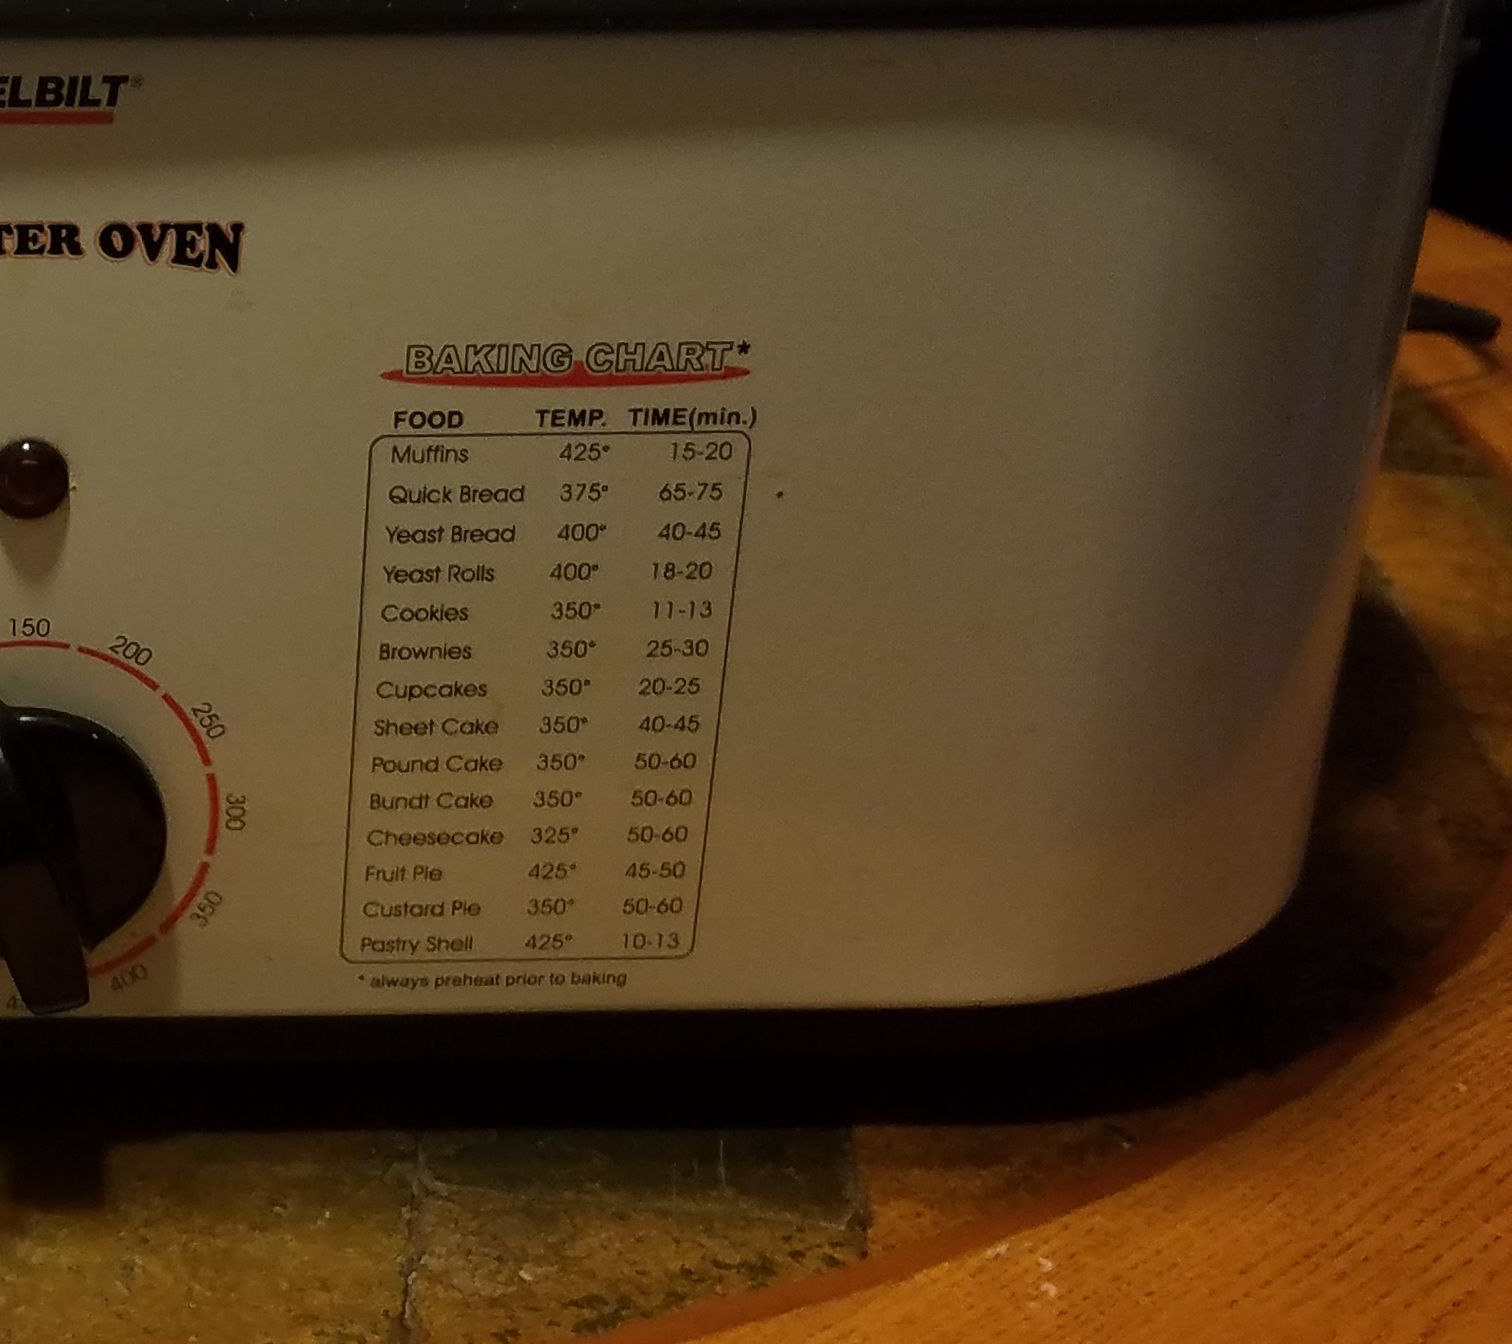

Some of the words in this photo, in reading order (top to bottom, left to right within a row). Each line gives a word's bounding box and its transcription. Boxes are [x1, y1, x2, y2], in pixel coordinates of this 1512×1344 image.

[97, 222, 246, 276] OVEN
[405, 343, 572, 375] BAKING
[394, 410, 464, 429] FOOD
[535, 408, 606, 428] TEMP.
[629, 407, 757, 433] TIME(min.)
[391, 444, 469, 464] Muffins
[671, 442, 733, 461] 15-20
[388, 486, 452, 506] Quick
[460, 485, 525, 503] Bread
[659, 484, 723, 502] 65-75
[385, 526, 446, 545] Yeast
[451, 525, 515, 544] Bread
[657, 523, 721, 541] 40-45
[383, 566, 442, 584] Yeast
[448, 565, 494, 583] Rolls
[651, 562, 712, 580] 18-20
[381, 604, 469, 623] Cookies
[653, 601, 713, 620] 11-13
[9, 617, 51, 638] 150
[110, 634, 153, 667] 200
[379, 642, 472, 661] Brownies
[646, 639, 709, 658] 25-30
[376, 681, 487, 702] Cupcakes
[638, 678, 700, 696] 20-25
[191, 701, 227, 741] 250
[374, 719, 436, 736] Sheet
[441, 718, 499, 736] Cake
[638, 715, 700, 733] 40-45
[371, 756, 440, 773] Pound
[446, 755, 503, 772] Cake
[635, 752, 696, 770] 50-60
[369, 793, 431, 810] Bundt
[437, 792, 493, 809] Cake
[631, 789, 692, 807] 50-60
[224, 793, 246, 832] 300
[367, 829, 504, 846] Cheesecake
[627, 825, 688, 843] 50-60
[365, 865, 407, 882] Fruit
[412, 865, 442, 882] Pie
[625, 861, 685, 879] 45-50
[189, 890, 223, 929] 350
[362, 900, 444, 918] Custard
[451, 900, 481, 917] Pie
[622, 897, 682, 915] 50-60
[360, 936, 420, 955] Pastry
[427, 934, 473, 952] Shell
[623, 932, 680, 949] 10-13
[110, 964, 148, 993] 400
[370, 973, 430, 990] always
[434, 972, 500, 988] preheat
[504, 972, 545, 988] prior
[549, 972, 565, 987] to
[571, 970, 626, 988] baking
